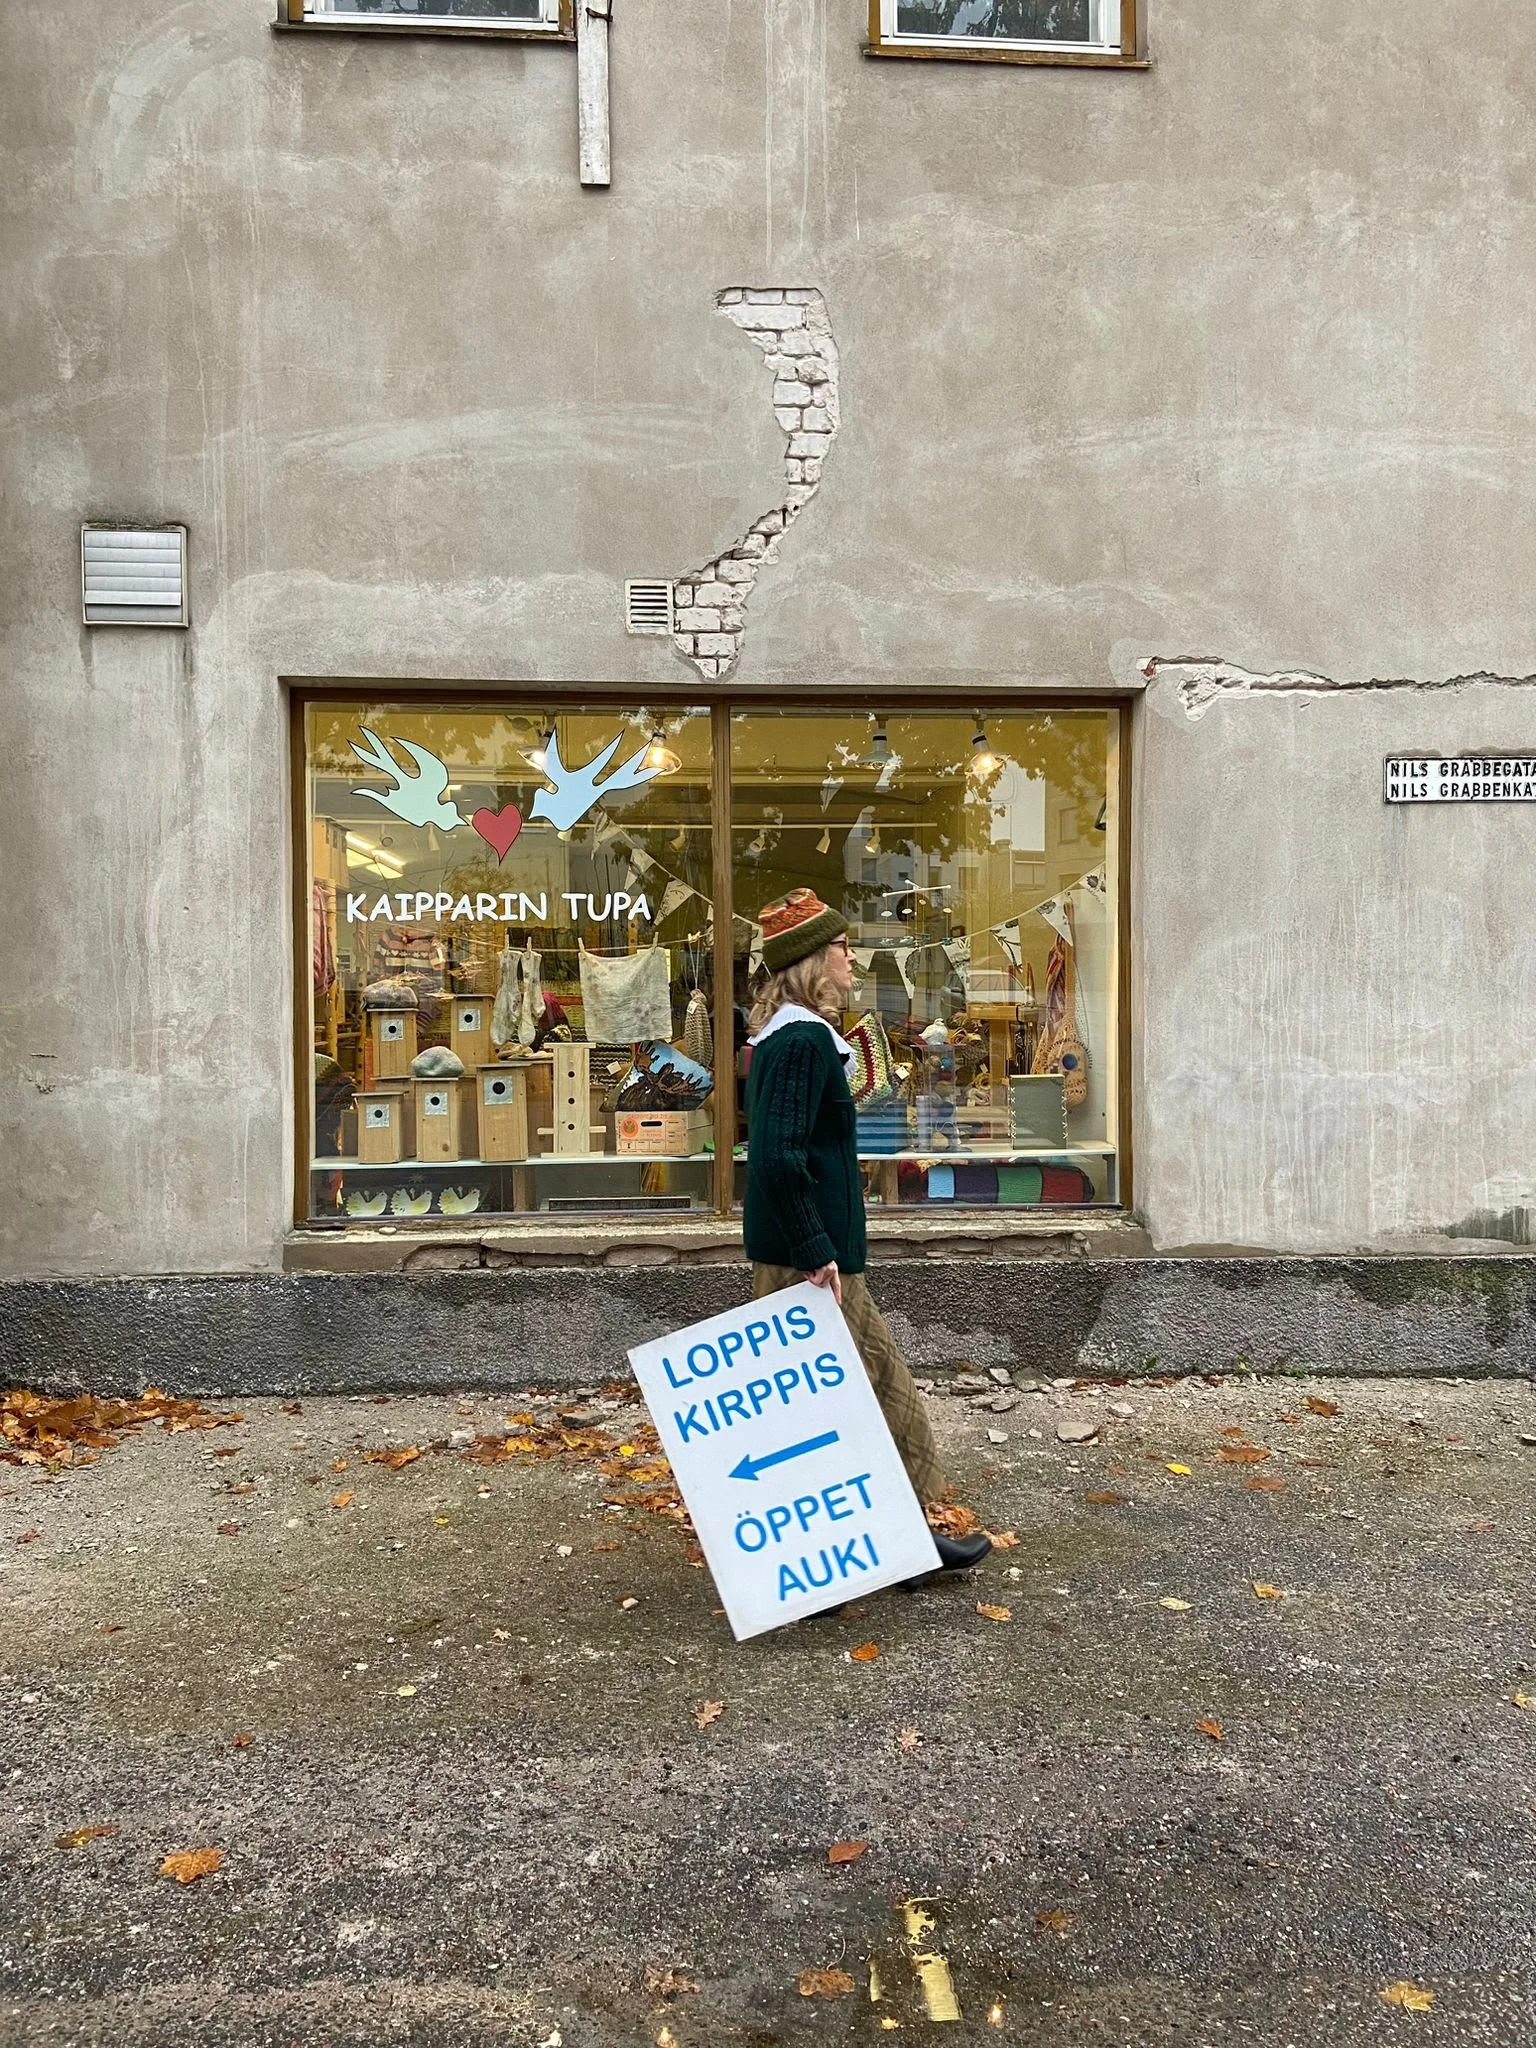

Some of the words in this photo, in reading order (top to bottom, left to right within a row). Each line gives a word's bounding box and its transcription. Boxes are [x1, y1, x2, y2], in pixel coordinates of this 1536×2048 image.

[1390, 762, 1428, 777] NILS
[1390, 783, 1428, 798] NILS
[347, 892, 547, 922] KAIPPARIN
[561, 892, 652, 921] TUPA
[662, 1305, 817, 1389] LOPPIS
[673, 1352, 846, 1443] KIRPPIS
[734, 1473, 872, 1553] ÖPPET
[777, 1534, 880, 1601] AUKI
